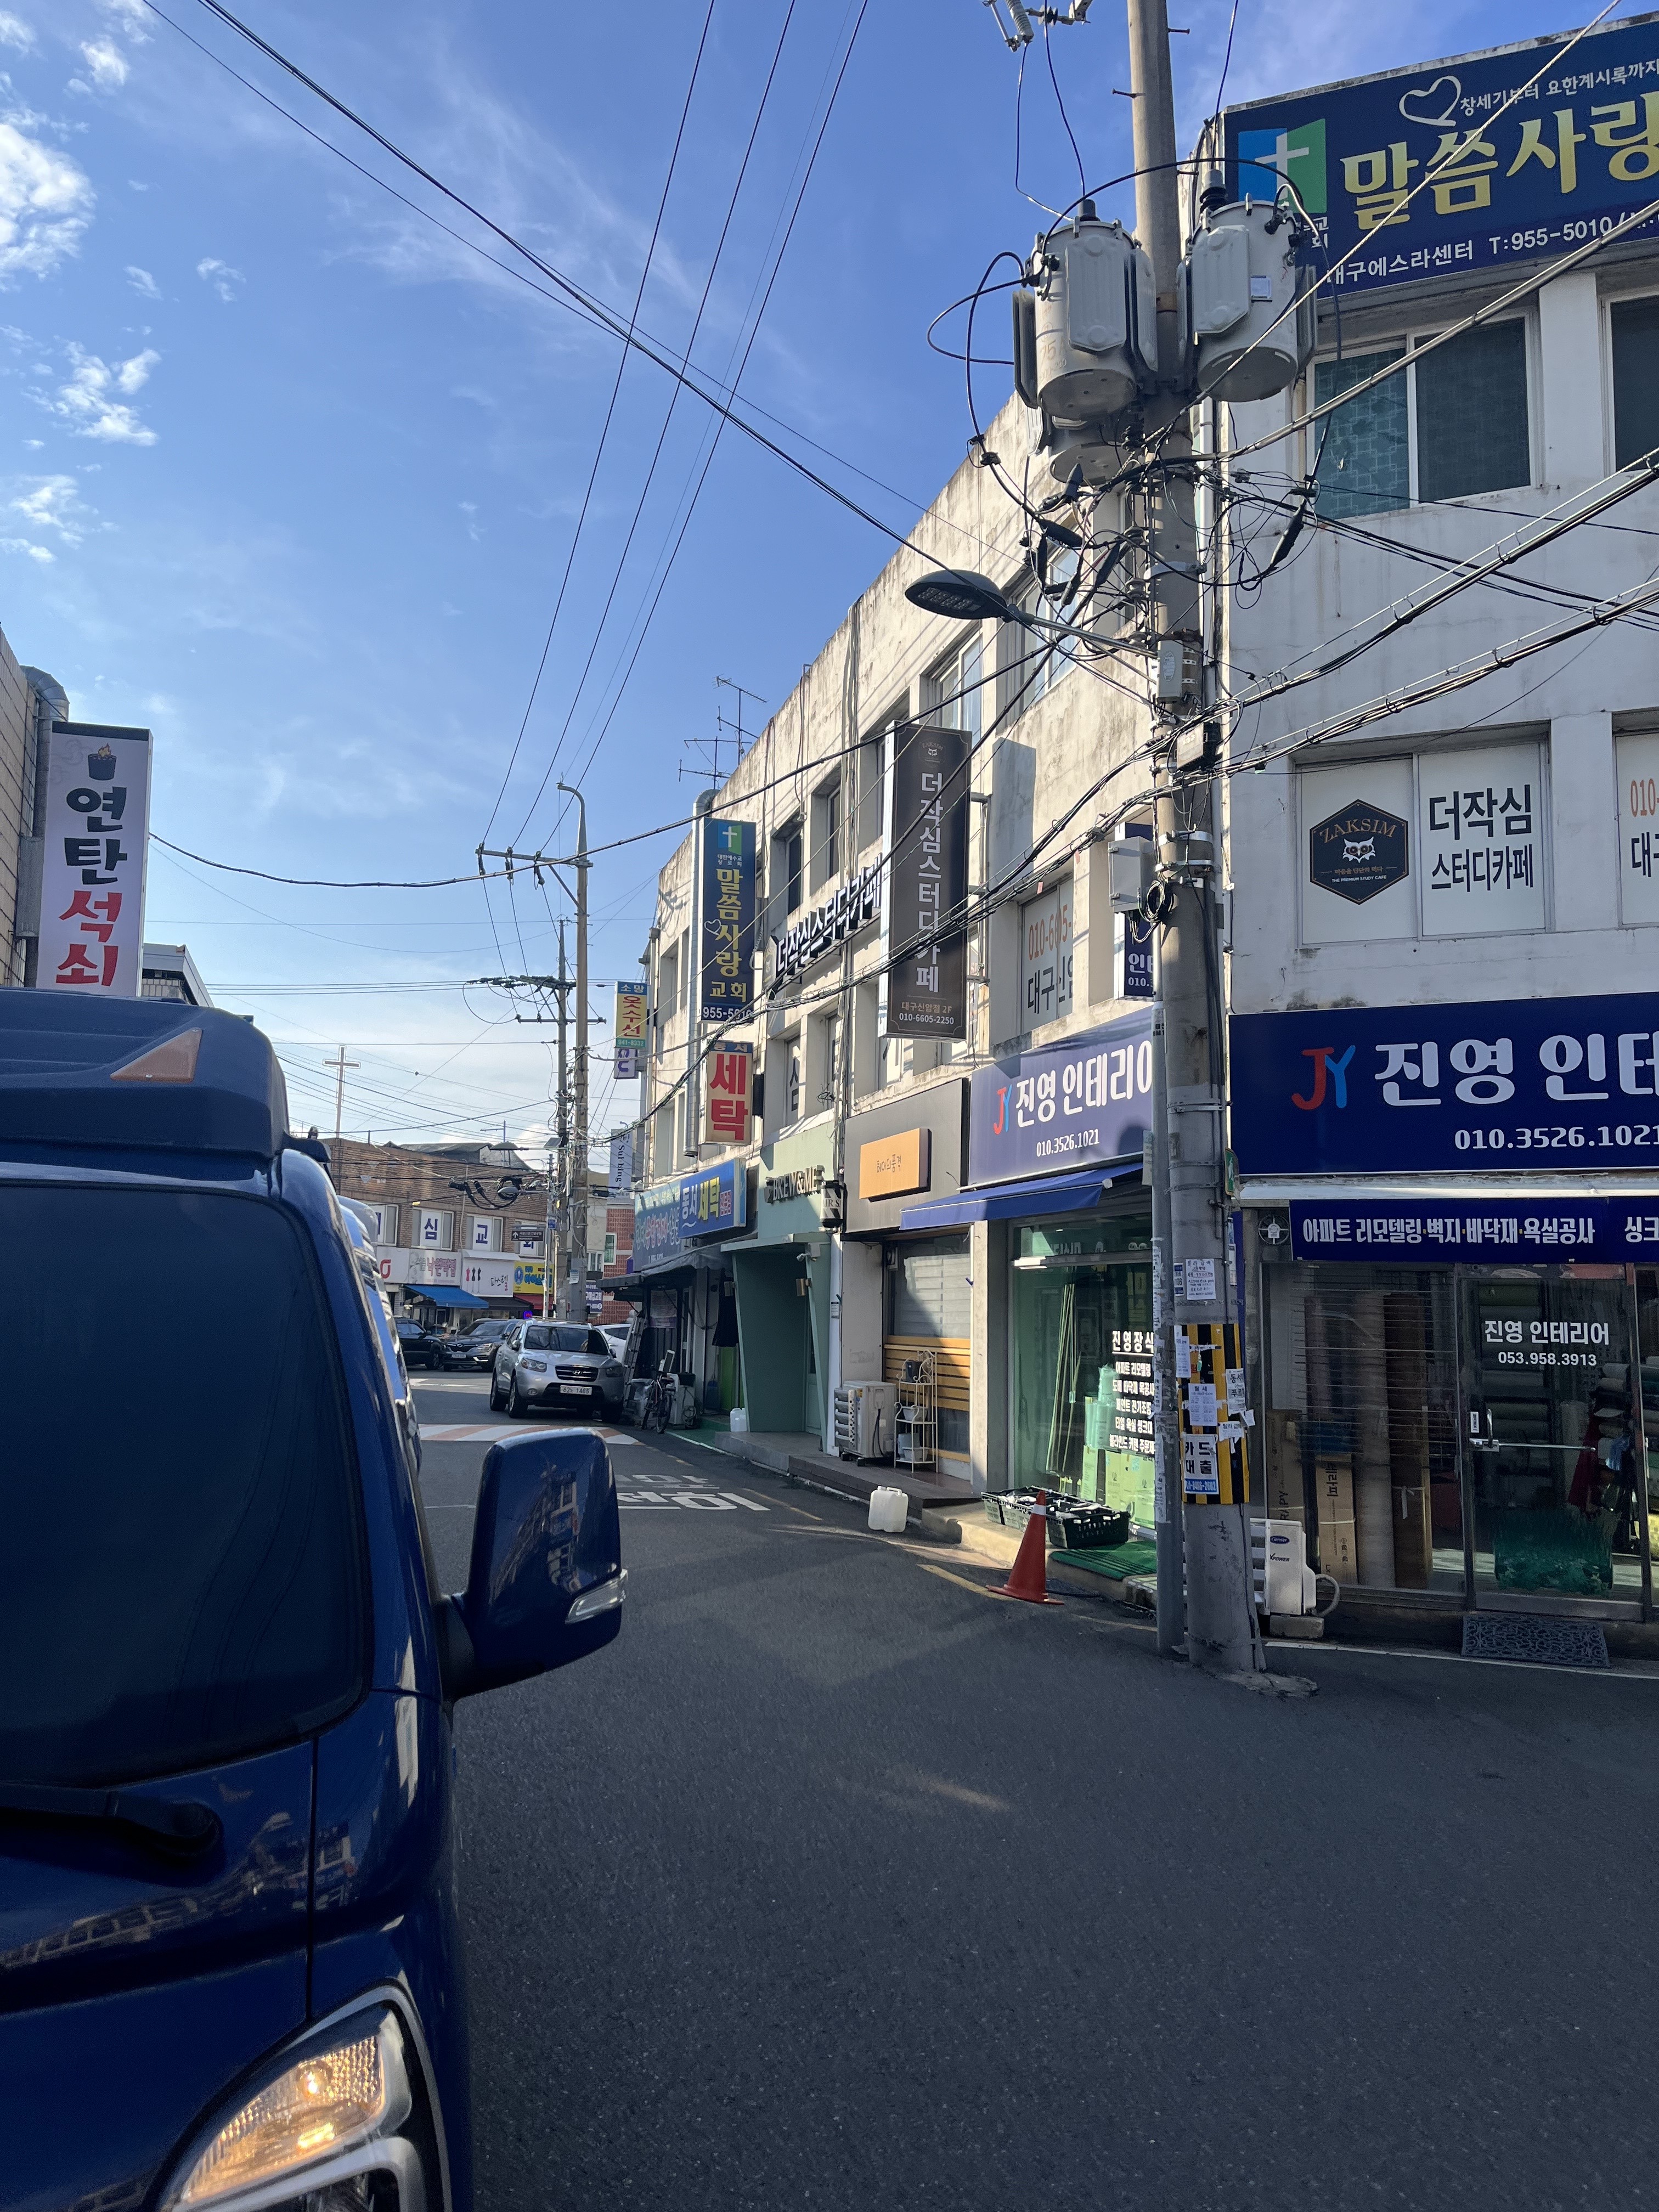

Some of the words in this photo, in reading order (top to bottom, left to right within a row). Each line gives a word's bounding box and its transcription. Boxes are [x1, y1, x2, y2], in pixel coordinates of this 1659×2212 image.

[1460, 83, 1539, 116] 창세기부터
[1339, 91, 1659, 232] 말씀사랑
[1429, 784, 1533, 840] 더작심
[1319, 818, 1398, 844] ZAKSIM
[1430, 843, 1534, 893] 스터디카페
[715, 867, 744, 978] 말씀사랑
[620, 984, 645, 994] 소망
[709, 980, 747, 1003] 교회
[621, 996, 642, 1037] 옷수선
[899, 1012, 955, 1025] 010-6605-2250
[901, 1001, 940, 1013] 대구신암점
[942, 1005, 952, 1013] 2F
[1374, 1037, 1515, 1107] 진영
[709, 1053, 749, 1142] 세탁
[1015, 1070, 1056, 1128] 진영
[1036, 1128, 1100, 1158] 010.3526.1021
[772, 1166, 818, 1201] BREW&ME
[682, 1184, 698, 1220] 동서
[698, 1176, 720, 1221] 세탁
[1302, 1218, 1352, 1243] 아파트
[1356, 1218, 1422, 1244] 리모델링
[1426, 1218, 1462, 1244] 벽지
[1466, 1217, 1518, 1244] 바닥재
[1523, 1217, 1595, 1244] 욕실공사
[1112, 1330, 1154, 1353] 진영장식
[1485, 1321, 1522, 1344] 진영
[1530, 1321, 1610, 1346] 인테리어
[1115, 1361, 1130, 1374] 아파트
[1131, 1362, 1152, 1378] 리모델링
[1498, 1351, 1597, 1367] 053.958.3913
[1116, 1398, 1131, 1412] 페인트
[1115, 1416, 1125, 1431] 타일
[1126, 1418, 1136, 1432] 욕실
[1185, 1441, 1211, 1455] 카드
[1186, 1459, 1212, 1475] 대출
